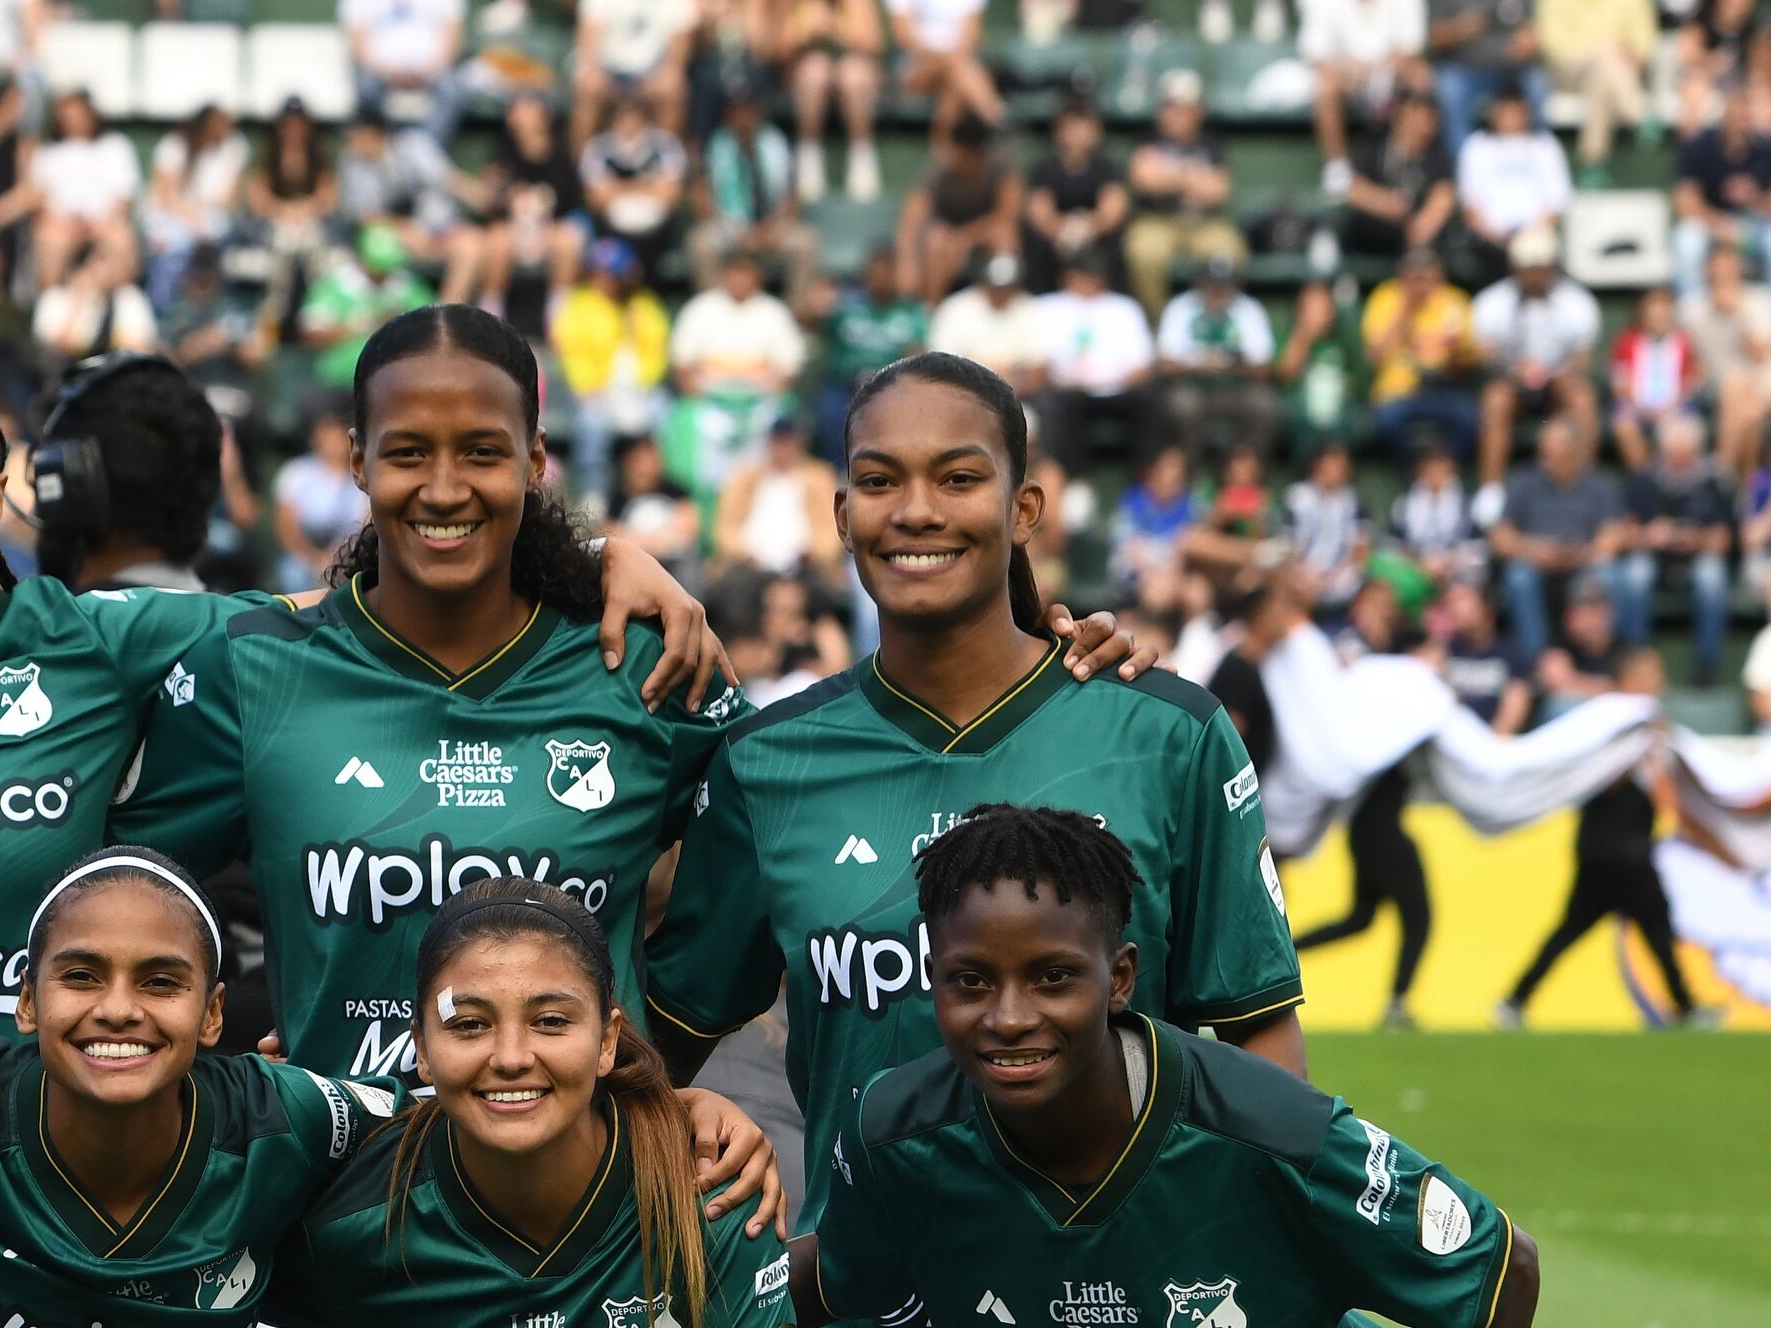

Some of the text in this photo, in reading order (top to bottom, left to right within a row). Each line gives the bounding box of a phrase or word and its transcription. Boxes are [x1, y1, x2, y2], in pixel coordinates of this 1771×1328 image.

[437, 739, 503, 765] Little
[554, 747, 604, 759] DEPORTIVO
[419, 758, 513, 784] Caesars
[556, 757, 604, 802] CALI
[437, 783, 507, 807] Pizza
[345, 999, 413, 1019] PASTAS
[1382, 1211, 1391, 1223] El
[202, 1269, 247, 1290] CALI
[1063, 1280, 1126, 1305] Little
[1173, 1288, 1229, 1301] DEPORTIVO
[611, 1303, 665, 1318] DEPORTVO
[1049, 1299, 1139, 1324] Caesars
